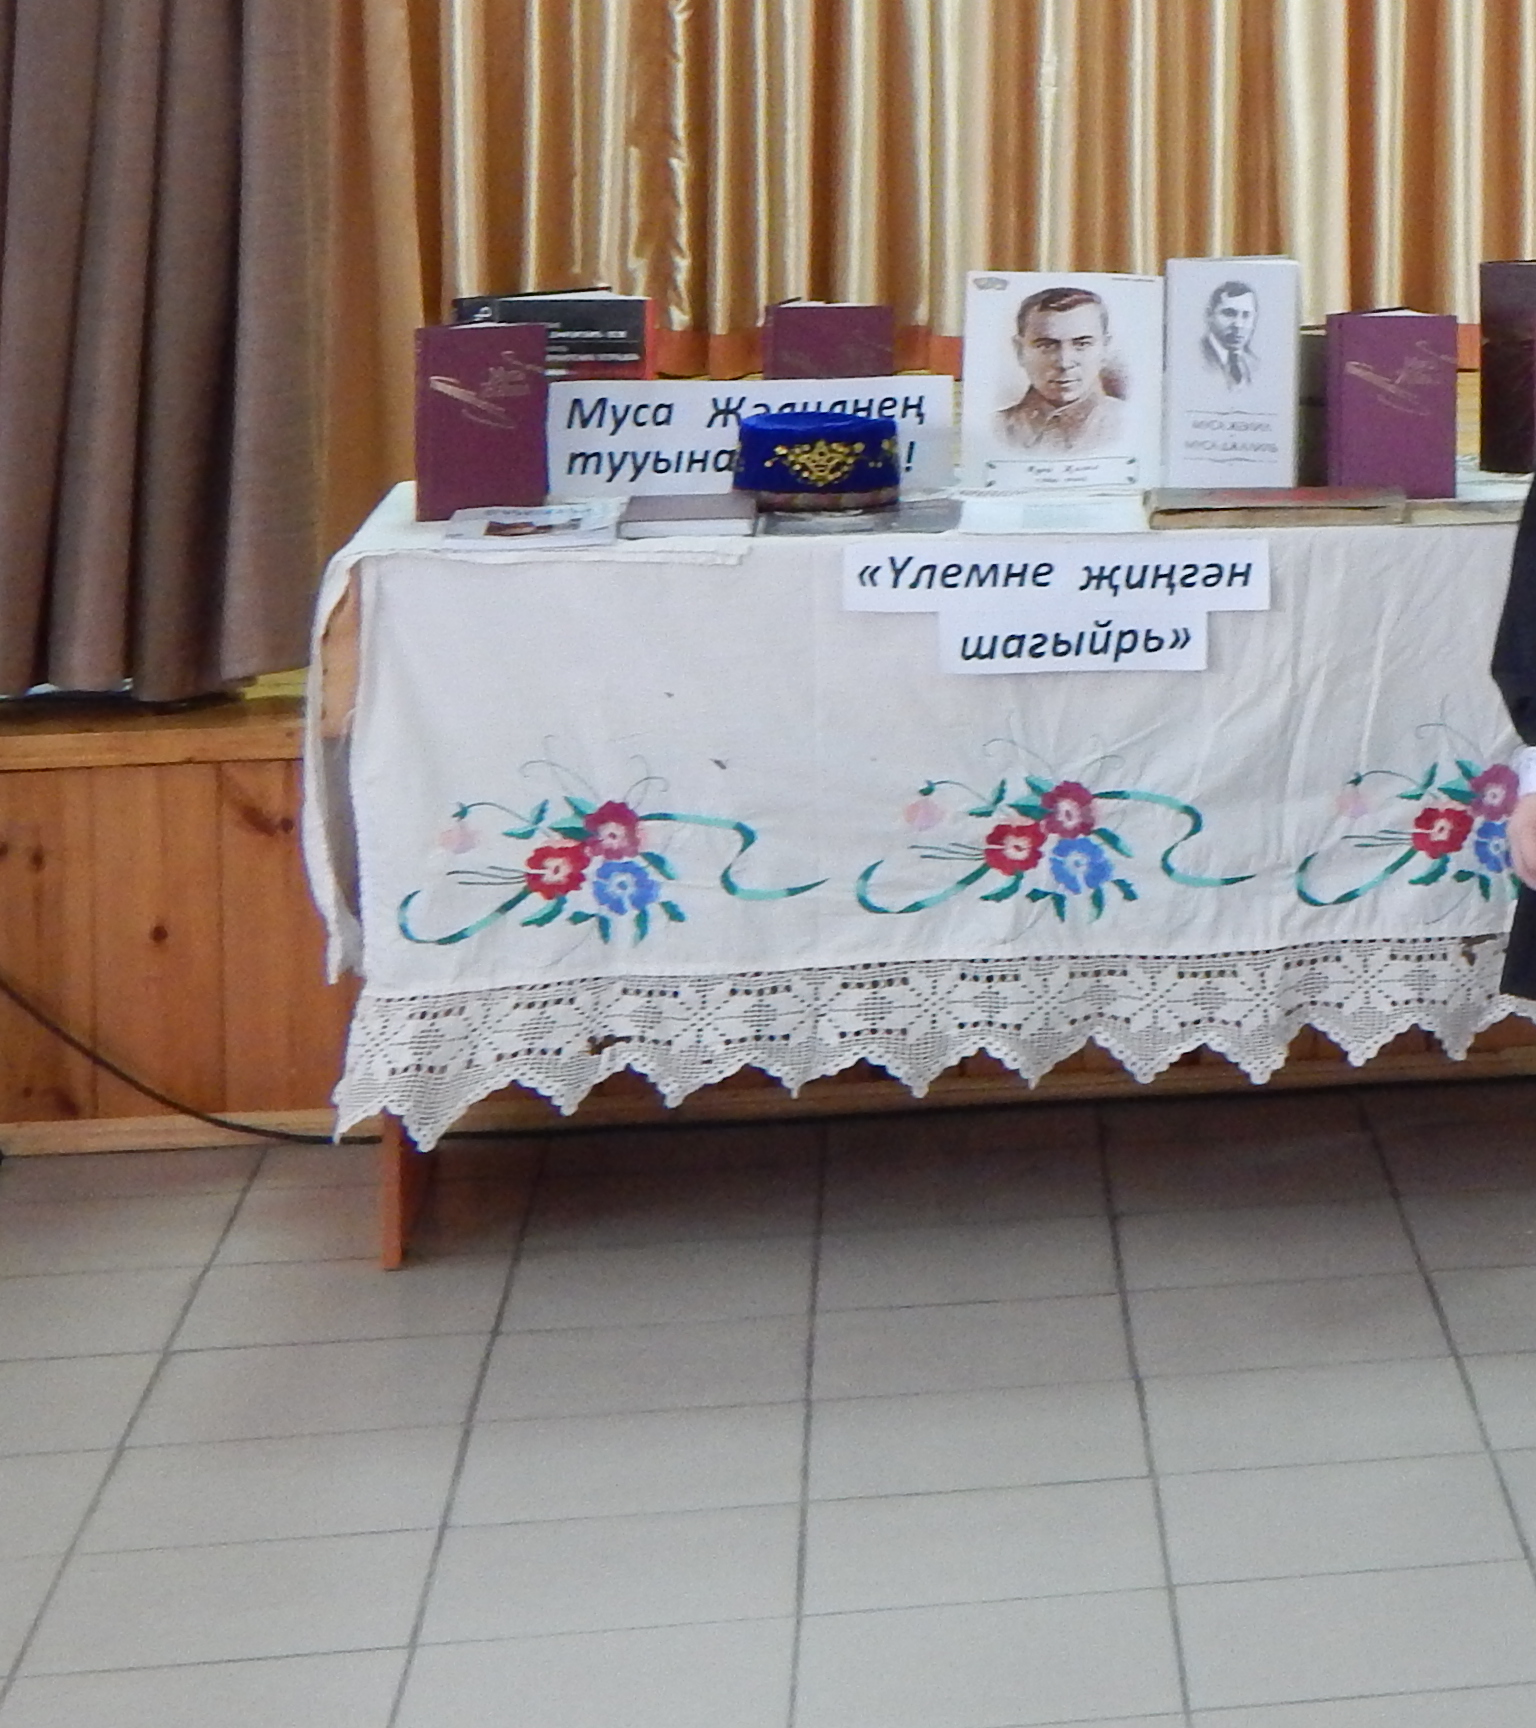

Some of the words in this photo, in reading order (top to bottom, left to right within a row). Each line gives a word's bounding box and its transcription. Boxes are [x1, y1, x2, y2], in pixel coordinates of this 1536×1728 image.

[566, 396, 674, 436] Муса
[566, 448, 737, 483] тууына
[858, 556, 1054, 590] «Үлемне
[1079, 561, 1253, 598] җиңгән
[960, 619, 1192, 663] шагыйрь»
